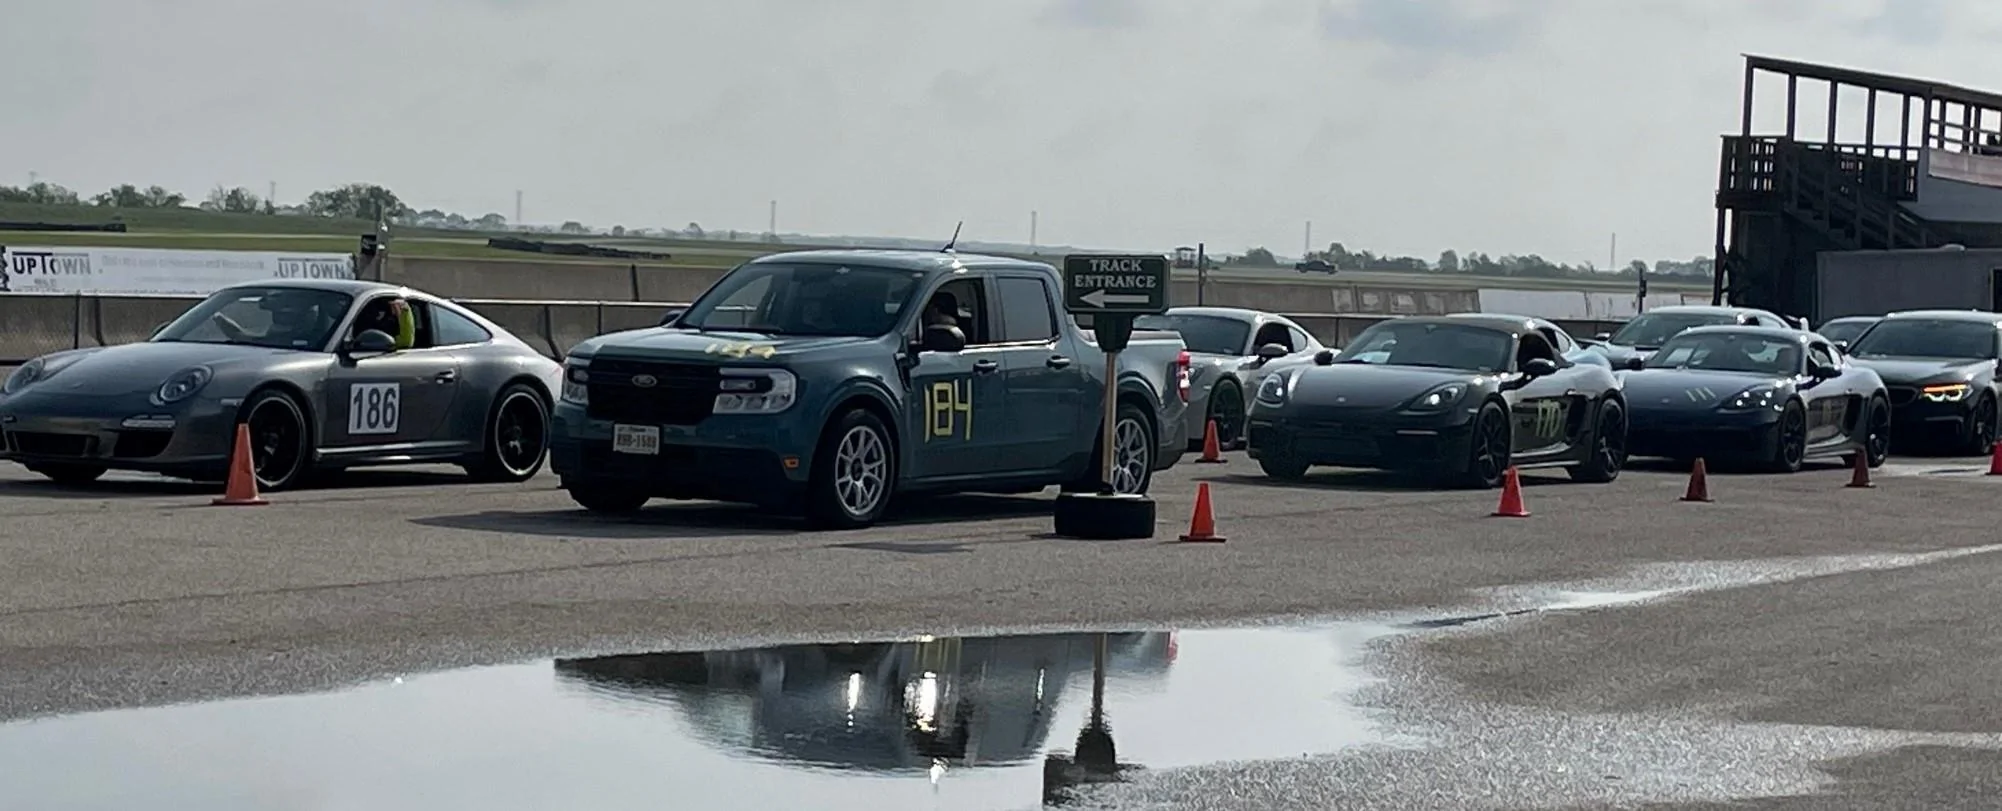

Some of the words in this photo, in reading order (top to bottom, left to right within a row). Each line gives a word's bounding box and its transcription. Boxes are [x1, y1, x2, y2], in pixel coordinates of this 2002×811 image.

[12, 251, 91, 275] UPTOWN
[278, 258, 346, 279] UPTOWN
[1088, 259, 1142, 272] TRACK
[1074, 274, 1157, 289] ENTRANCE
[353, 387, 397, 430] 186
[924, 378, 973, 443] 184
